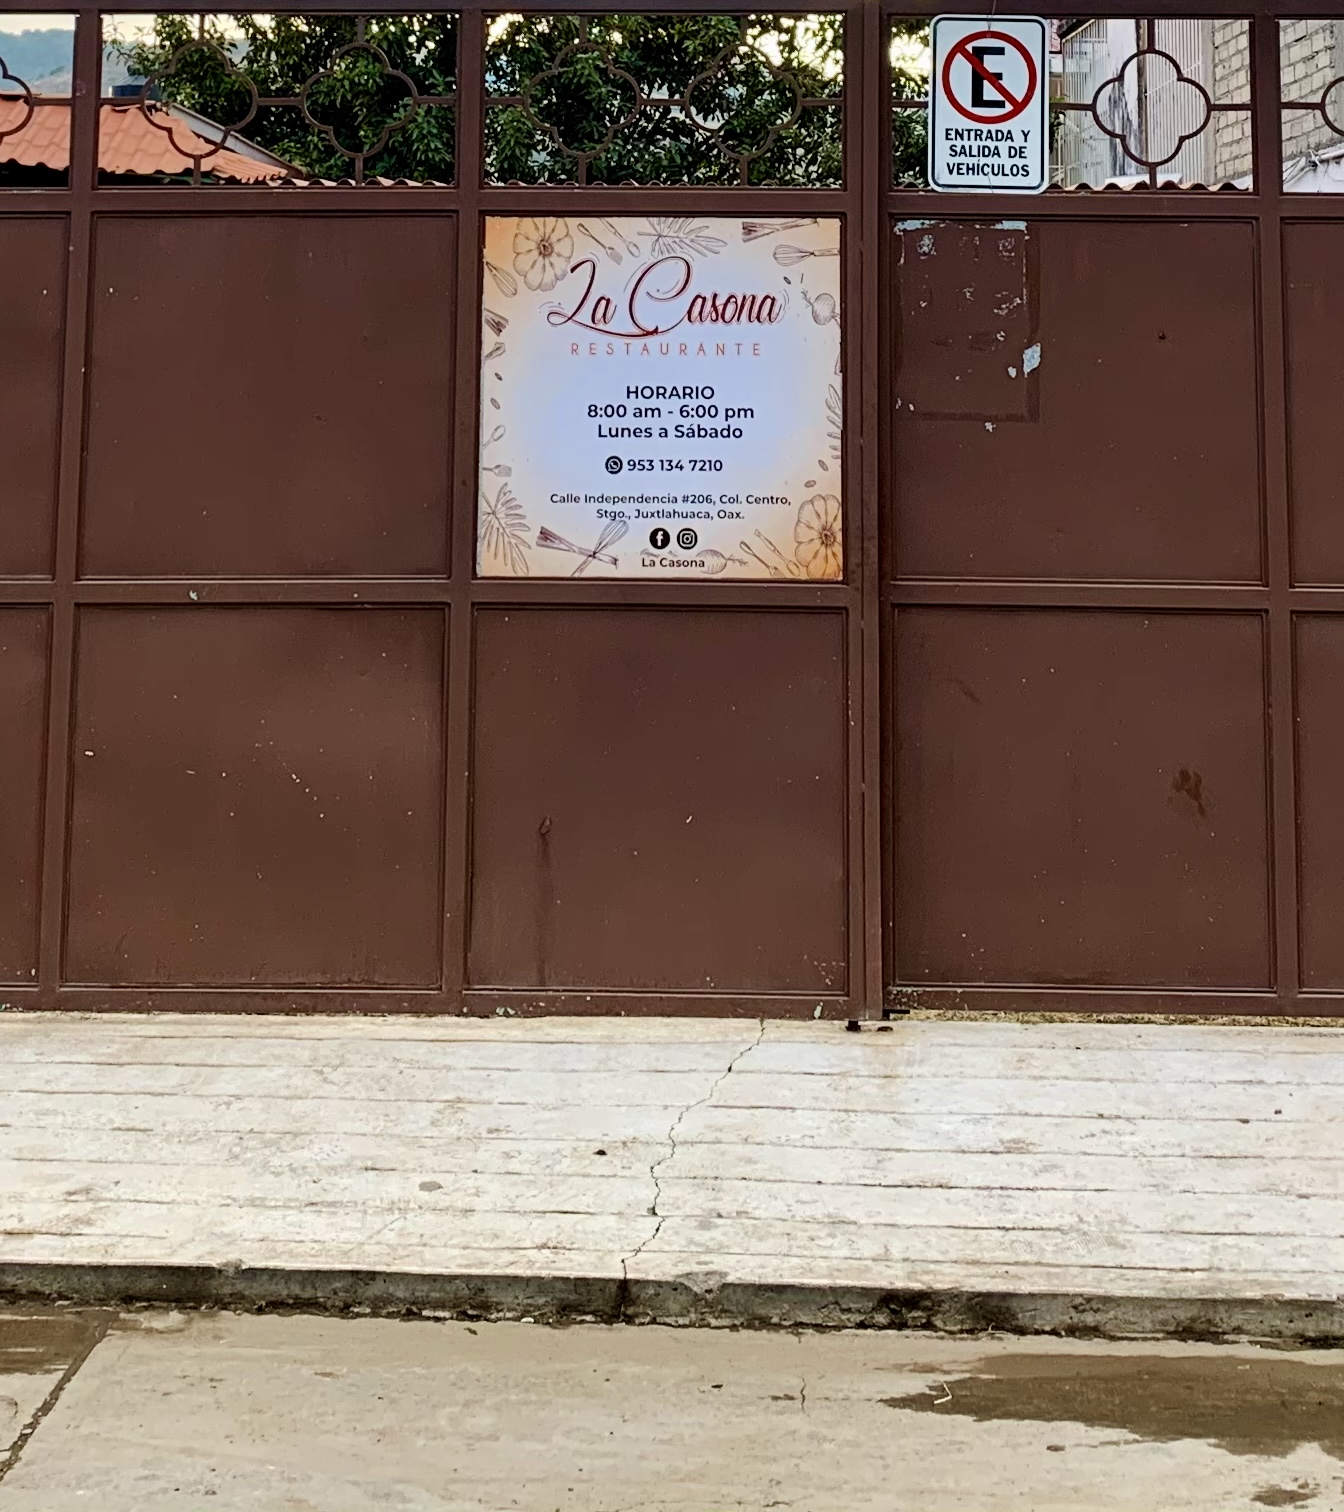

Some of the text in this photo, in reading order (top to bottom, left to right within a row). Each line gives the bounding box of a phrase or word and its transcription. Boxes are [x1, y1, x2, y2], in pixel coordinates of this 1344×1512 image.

[944, 128, 1031, 143] ENTRADA Y
[948, 144, 1028, 159] SALIDA DE
[946, 160, 1030, 178] VEHÍCULOS
[629, 256, 782, 334] Casona
[570, 342, 761, 356] RESTAURANTE
[625, 385, 715, 400] HORARIO
[587, 404, 627, 419] 8:00
[632, 406, 662, 419] am
[679, 404, 719, 419] 6:00
[725, 406, 755, 422] pm
[598, 423, 743, 439] Lunes a Sábado
[627, 459, 723, 472] 953 134 7210
[550, 493, 792, 507] Calle Independencia #206, Col. Centro,
[596, 508, 745, 522] Stgo., Juxtlahuaca, Oax.
[641, 557, 705, 569] La Casona
